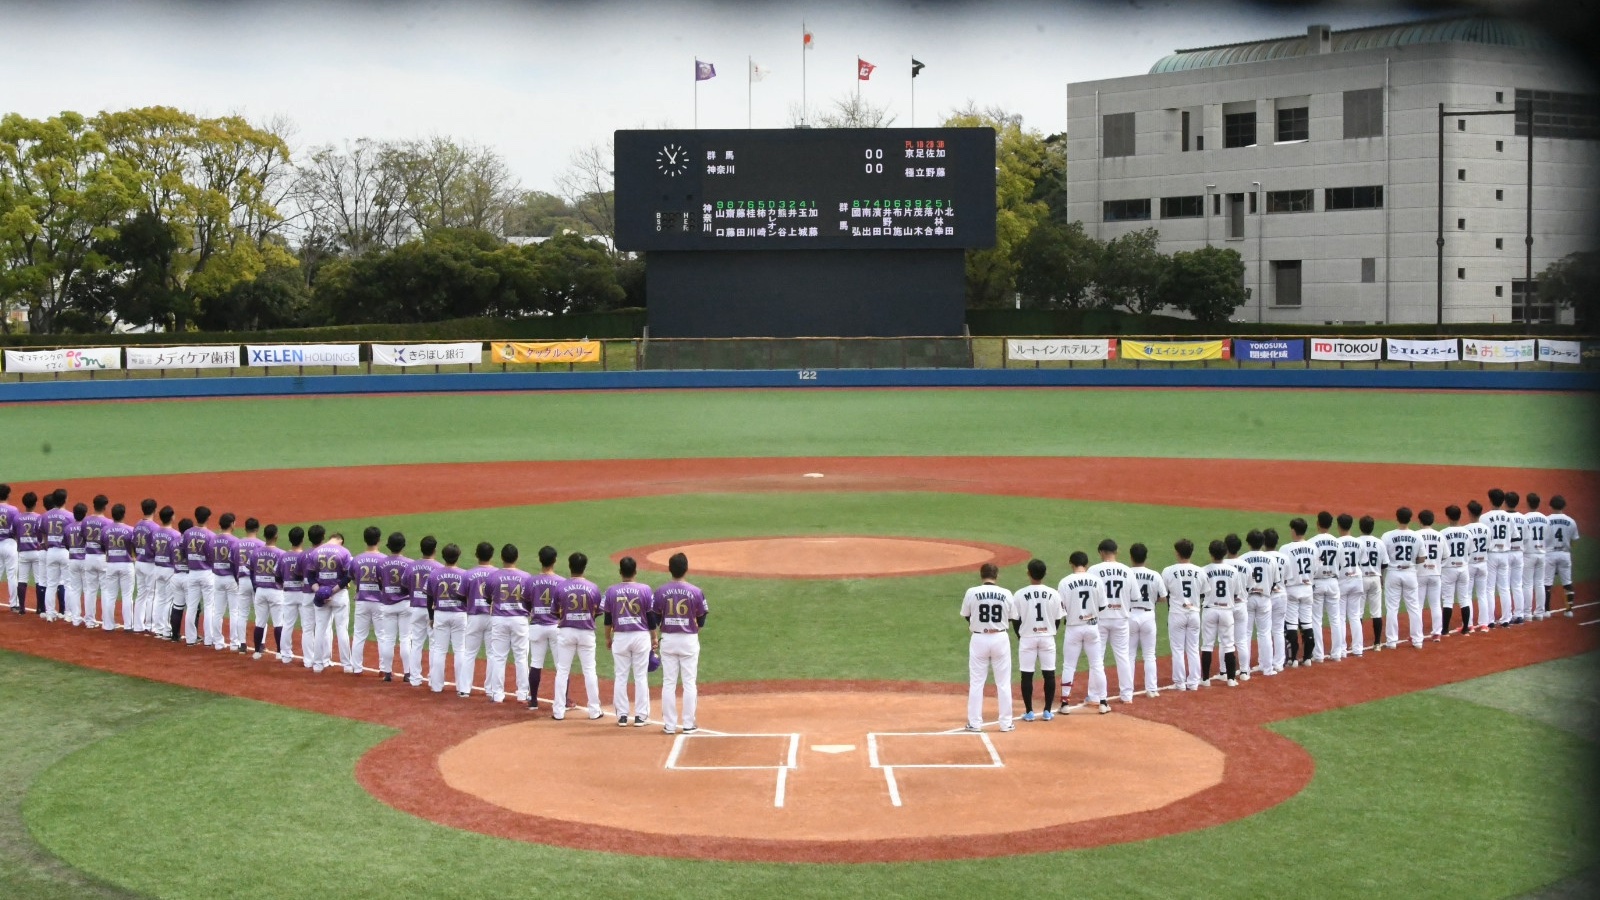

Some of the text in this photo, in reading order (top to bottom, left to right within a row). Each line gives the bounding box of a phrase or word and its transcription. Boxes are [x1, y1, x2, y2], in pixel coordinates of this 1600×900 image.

[706, 165, 734, 174] 神奈川
[702, 204, 712, 232] 神奈川
[253, 350, 356, 362] XELEN HOLDINGS
[409, 349, 464, 360] きらぼし銀行
[1334, 343, 1378, 353] ITOKOU
[154, 350, 235, 365] メディケア歯科
[798, 371, 817, 380] 122
[1493, 525, 1506, 539] 16
[1532, 526, 1543, 540] 11
[1555, 528, 1563, 542] 4
[1395, 546, 1413, 561] 28
[1450, 542, 1465, 557] 18
[1319, 550, 1337, 566] 47
[1174, 569, 1199, 578] FUSE
[1254, 566, 1263, 583] 6
[1297, 558, 1311, 575] 12
[500, 584, 522, 601] 54
[1068, 579, 1097, 590] HAMADA
[1105, 580, 1123, 598] 17
[1182, 581, 1192, 598] 5
[1216, 580, 1226, 598] 8
[540, 588, 551, 604] 4
[568, 593, 588, 611] 31
[1024, 591, 1052, 601] MOGI
[1079, 591, 1089, 609] 7
[616, 596, 641, 615] 76
[667, 598, 689, 616] 16
[979, 603, 1003, 623] 89
[1035, 603, 1044, 621] 1
